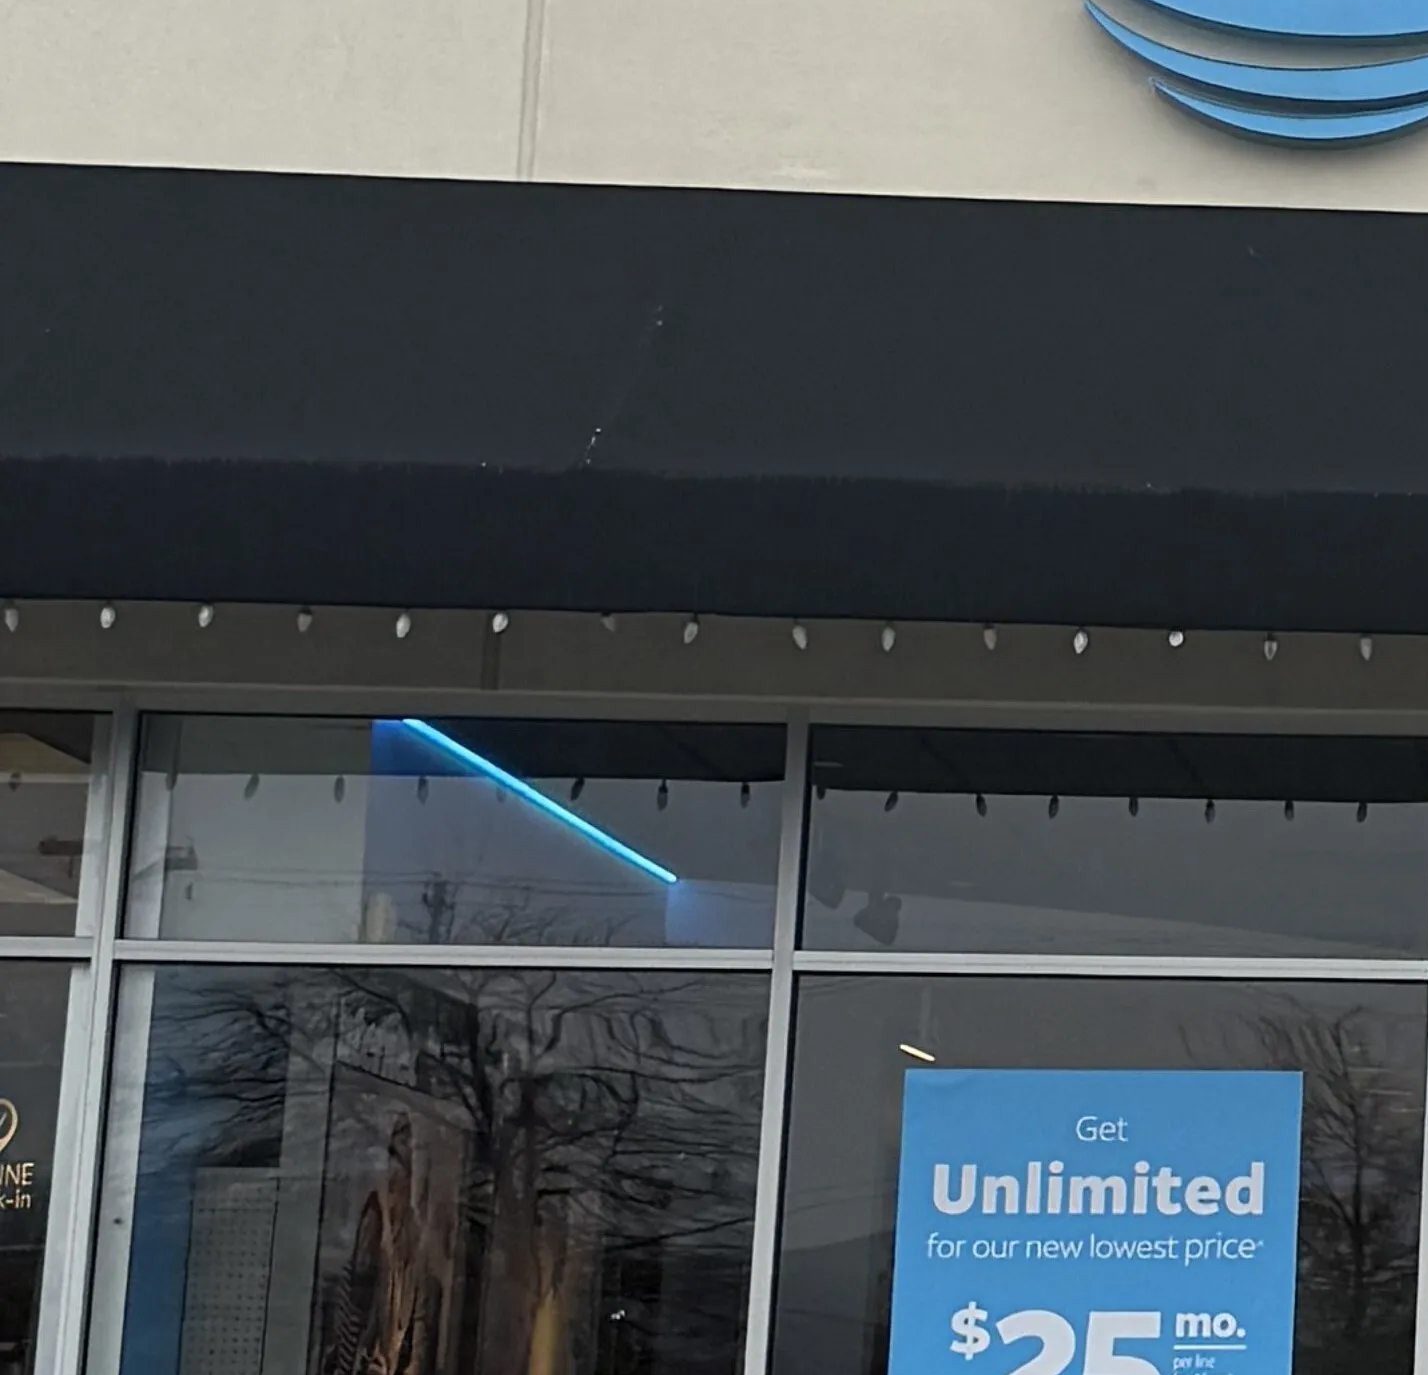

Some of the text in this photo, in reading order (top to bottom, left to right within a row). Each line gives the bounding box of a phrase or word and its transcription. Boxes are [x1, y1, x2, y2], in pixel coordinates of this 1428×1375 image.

[1075, 1115, 1129, 1143] Get
[932, 1160, 1266, 1217] Unlimited
[927, 1231, 967, 1259] for
[972, 1239, 1019, 1260] our
[1026, 1239, 1084, 1260] new
[1089, 1232, 1180, 1261] lowest
[1174, 1311, 1248, 1339] mo.
